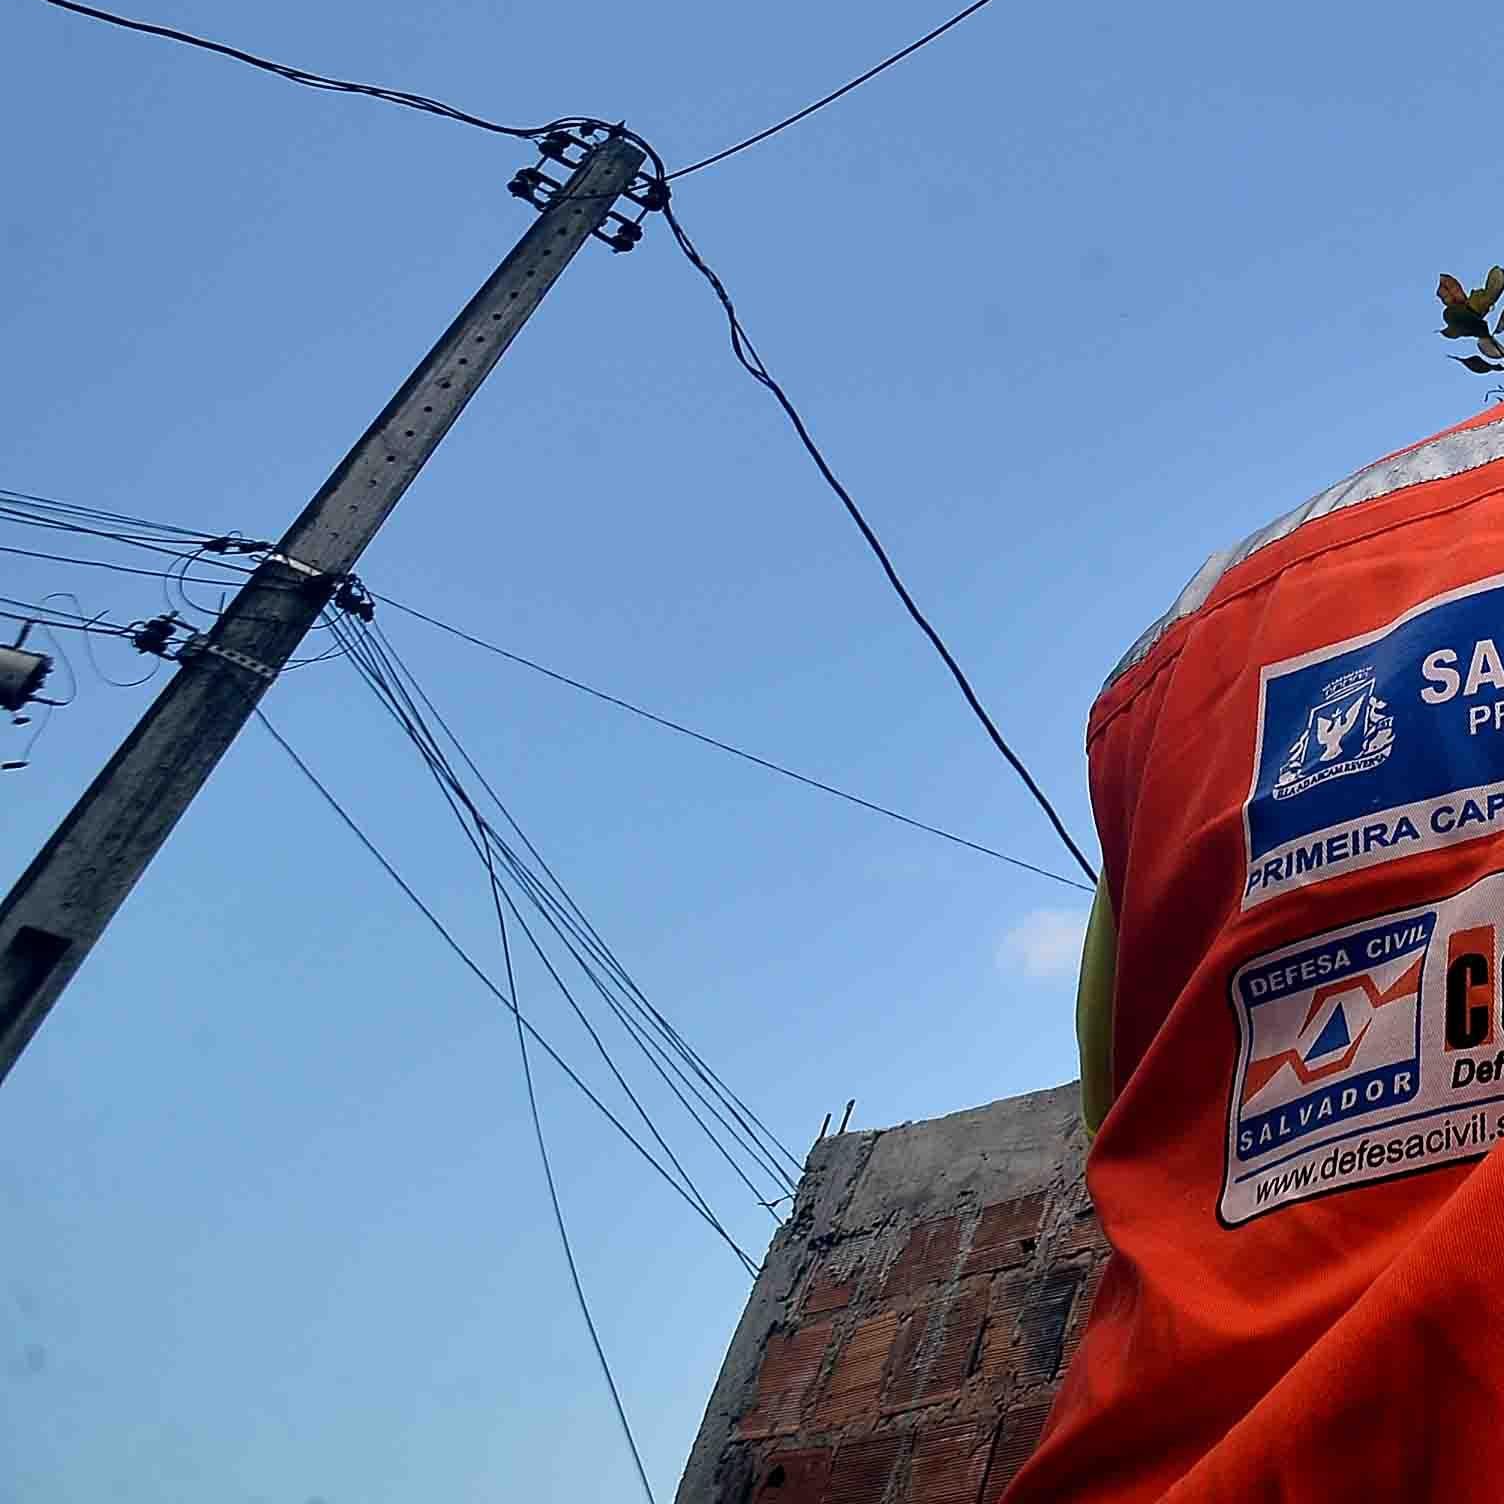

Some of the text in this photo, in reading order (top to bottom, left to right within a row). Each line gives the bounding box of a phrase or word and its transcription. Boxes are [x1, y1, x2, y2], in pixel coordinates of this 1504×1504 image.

[1247, 816, 1421, 890] PRIMEIRA
[1250, 922, 1428, 997] DEFESA CIVIL
[1240, 1071, 1414, 1152] SALVADOR
